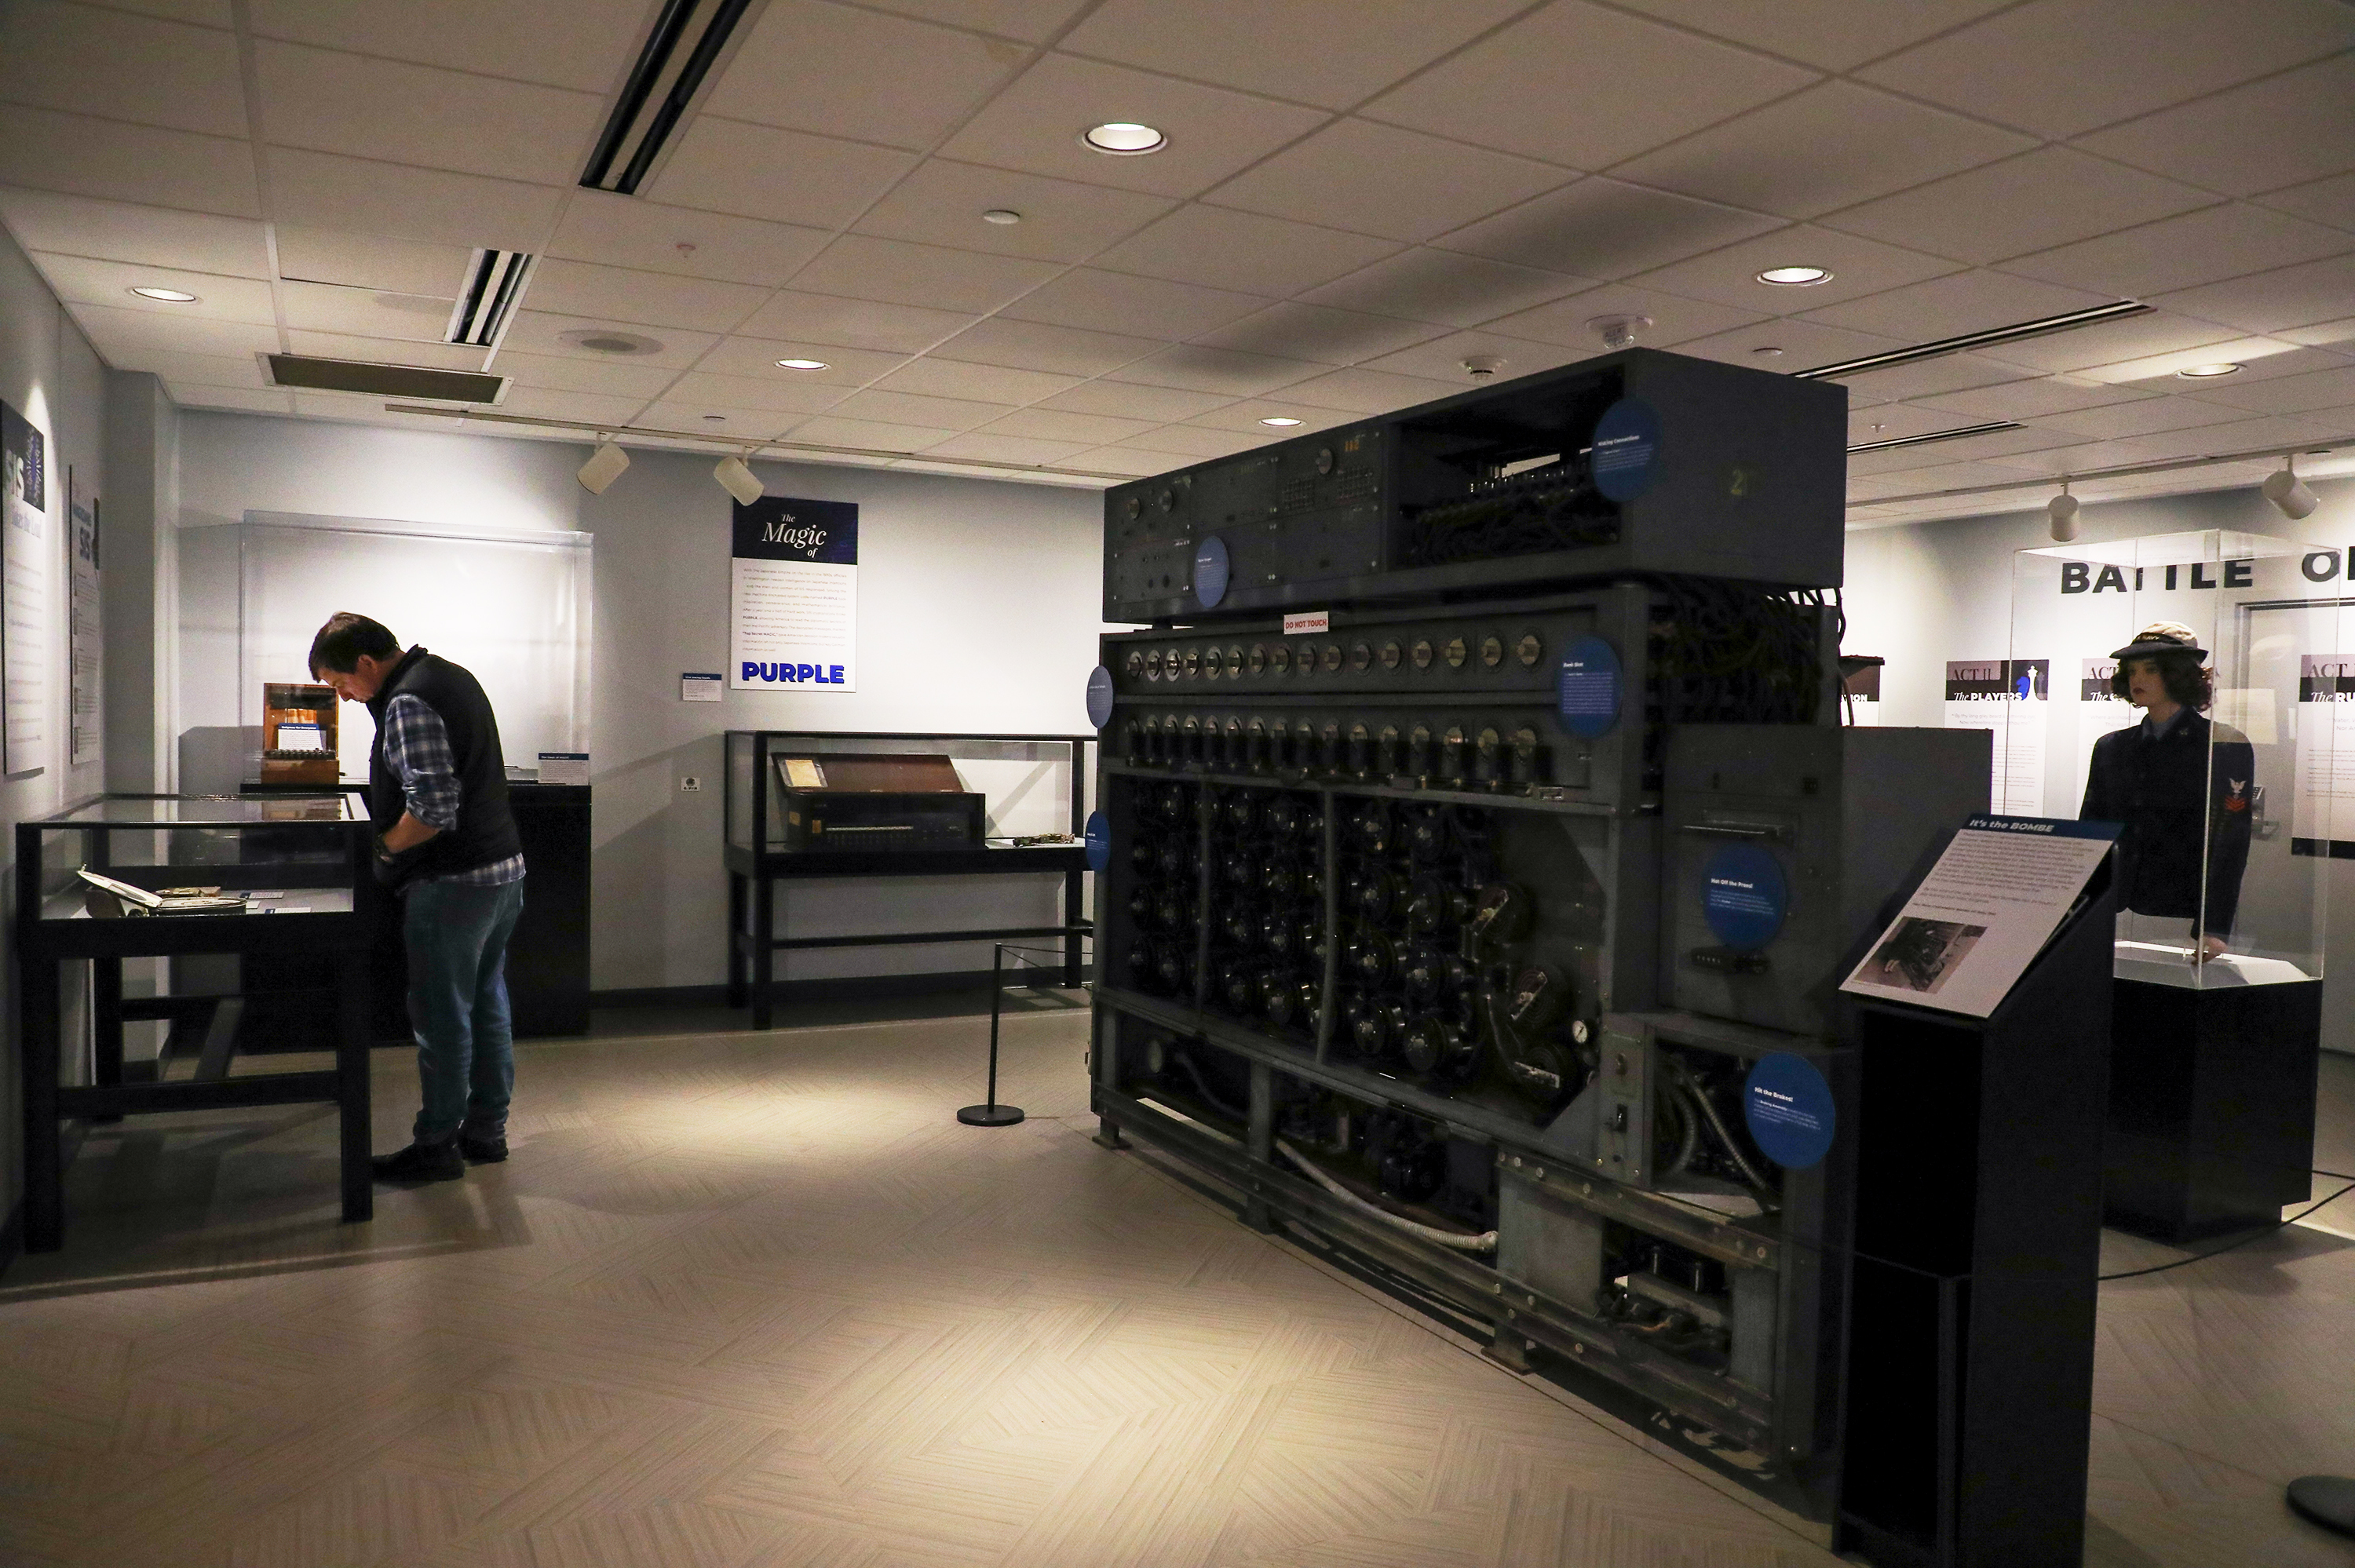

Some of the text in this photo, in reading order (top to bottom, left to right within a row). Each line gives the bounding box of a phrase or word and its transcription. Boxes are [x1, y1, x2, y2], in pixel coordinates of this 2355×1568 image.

[781, 513, 796, 523] The
[761, 522, 827, 549] Magic
[807, 548, 818, 559] of
[2302, 545, 2355, 582] O
[742, 662, 845, 684] PURPLE
[1951, 667, 1992, 680] ACT II
[2308, 663, 2347, 678] ACT
[1954, 691, 2023, 702] The PLAYERS
[2090, 691, 2109, 702] The
[2310, 691, 2334, 702] The
[1969, 819, 2055, 833] It's the BOMBE
[1763, 1088, 1773, 1097] the
